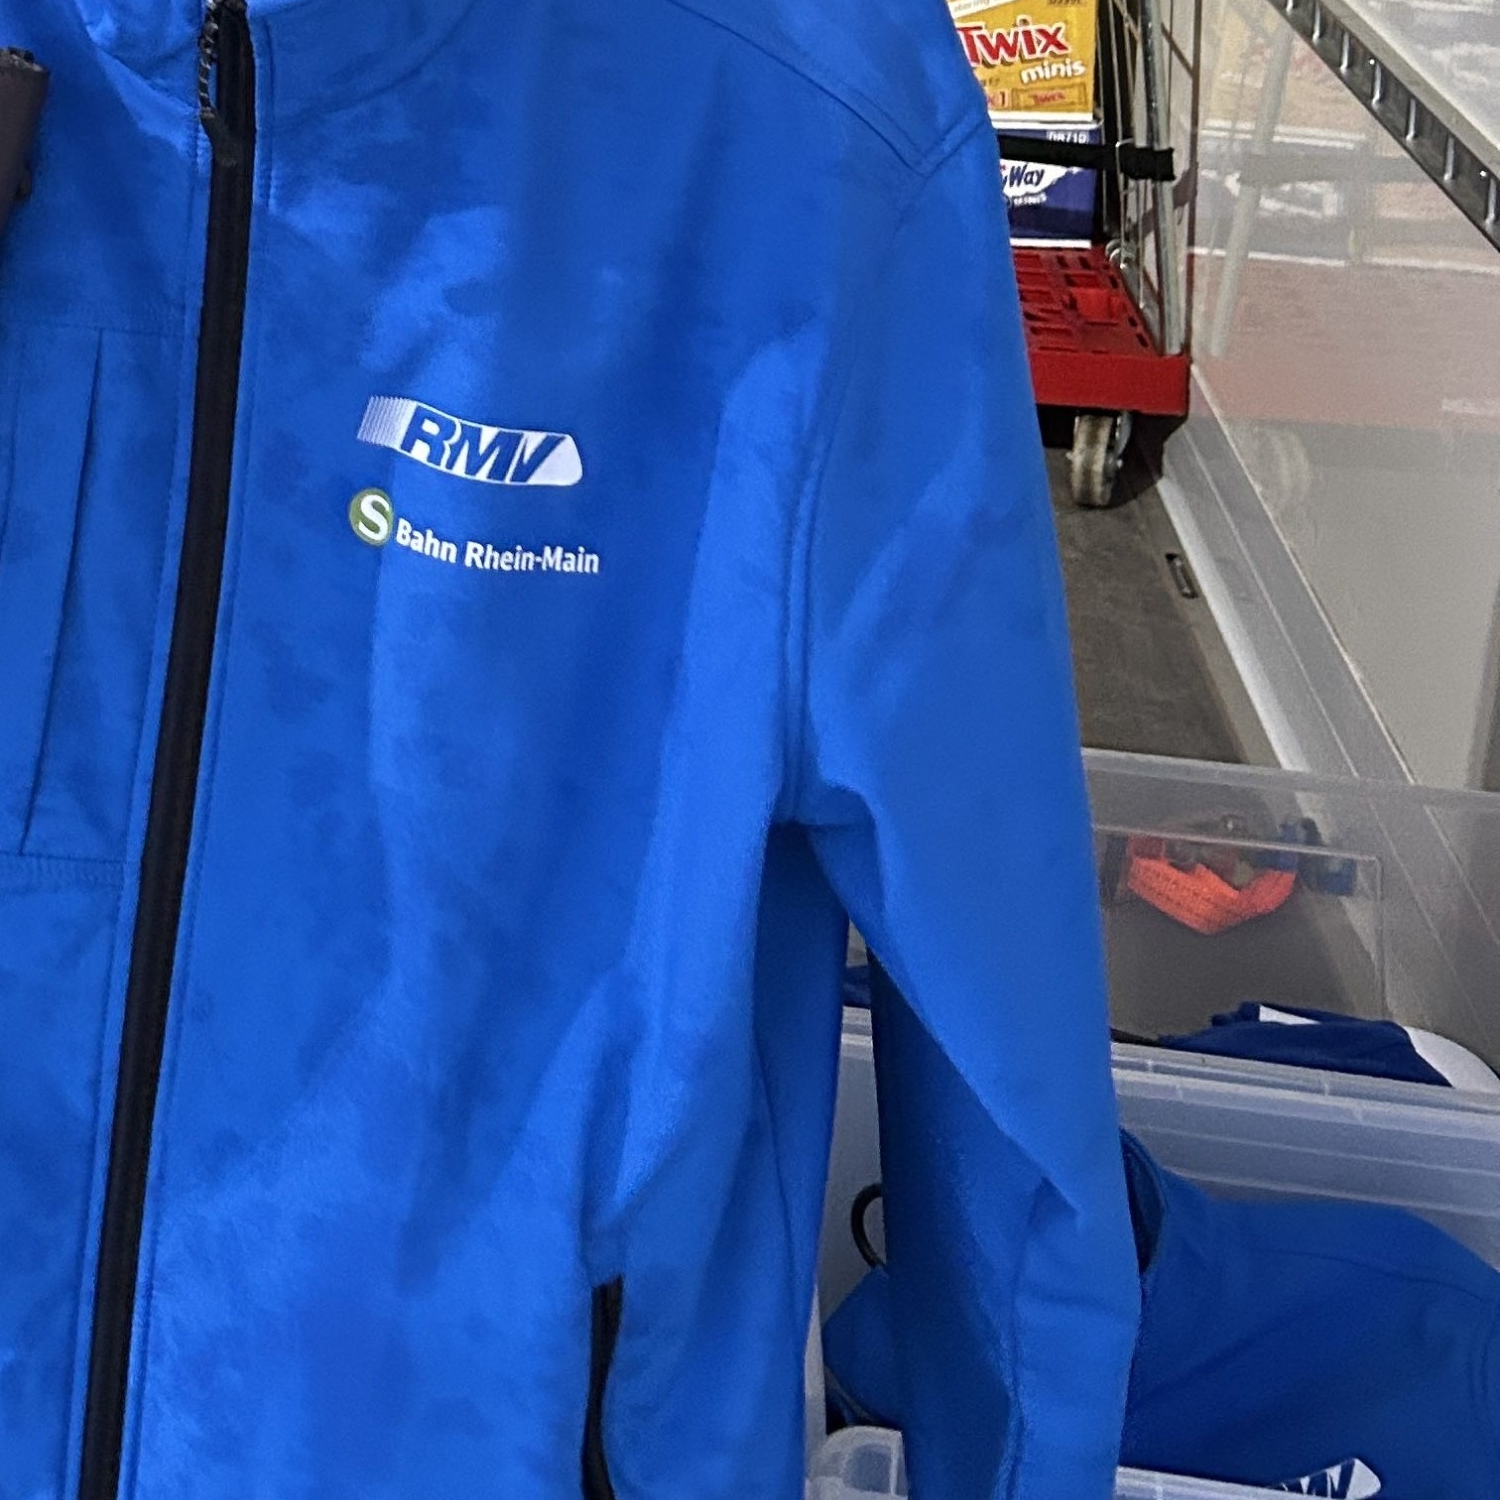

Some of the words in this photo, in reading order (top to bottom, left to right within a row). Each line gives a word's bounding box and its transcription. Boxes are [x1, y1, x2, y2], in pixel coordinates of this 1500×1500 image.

[955, 15, 1071, 67] Twix
[1020, 57, 1086, 84] minis
[1008, 162, 1045, 188] Way
[400, 404, 568, 484] RMV
[358, 493, 391, 542] S
[395, 517, 457, 564] Bahn
[464, 541, 600, 574] Rhein-Main
